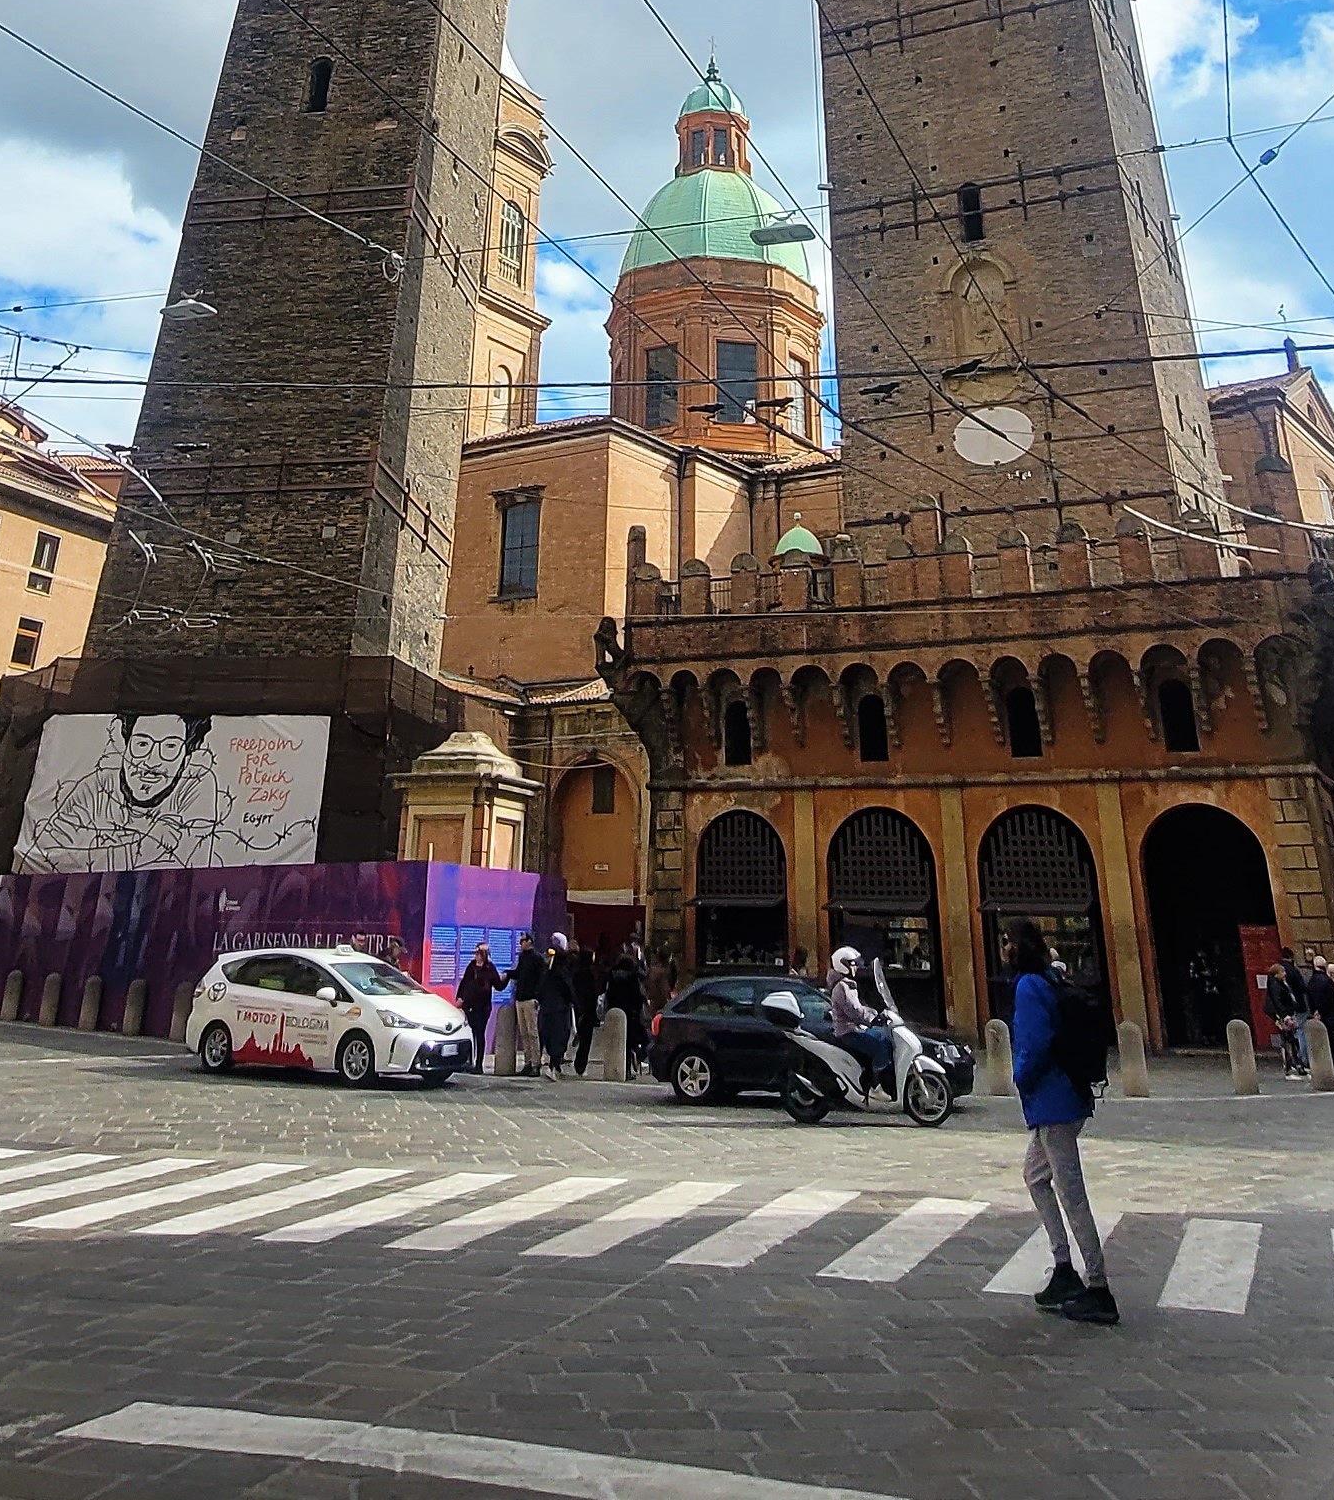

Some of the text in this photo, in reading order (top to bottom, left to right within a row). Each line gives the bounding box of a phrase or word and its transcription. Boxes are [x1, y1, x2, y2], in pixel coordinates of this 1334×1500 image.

[242, 812, 274, 828] EGYPT
[212, 931, 228, 952] LA
[232, 931, 310, 951] GARISENDA
[350, 933, 396, 955] ATRE
[243, 1011, 277, 1025] MOTOR
